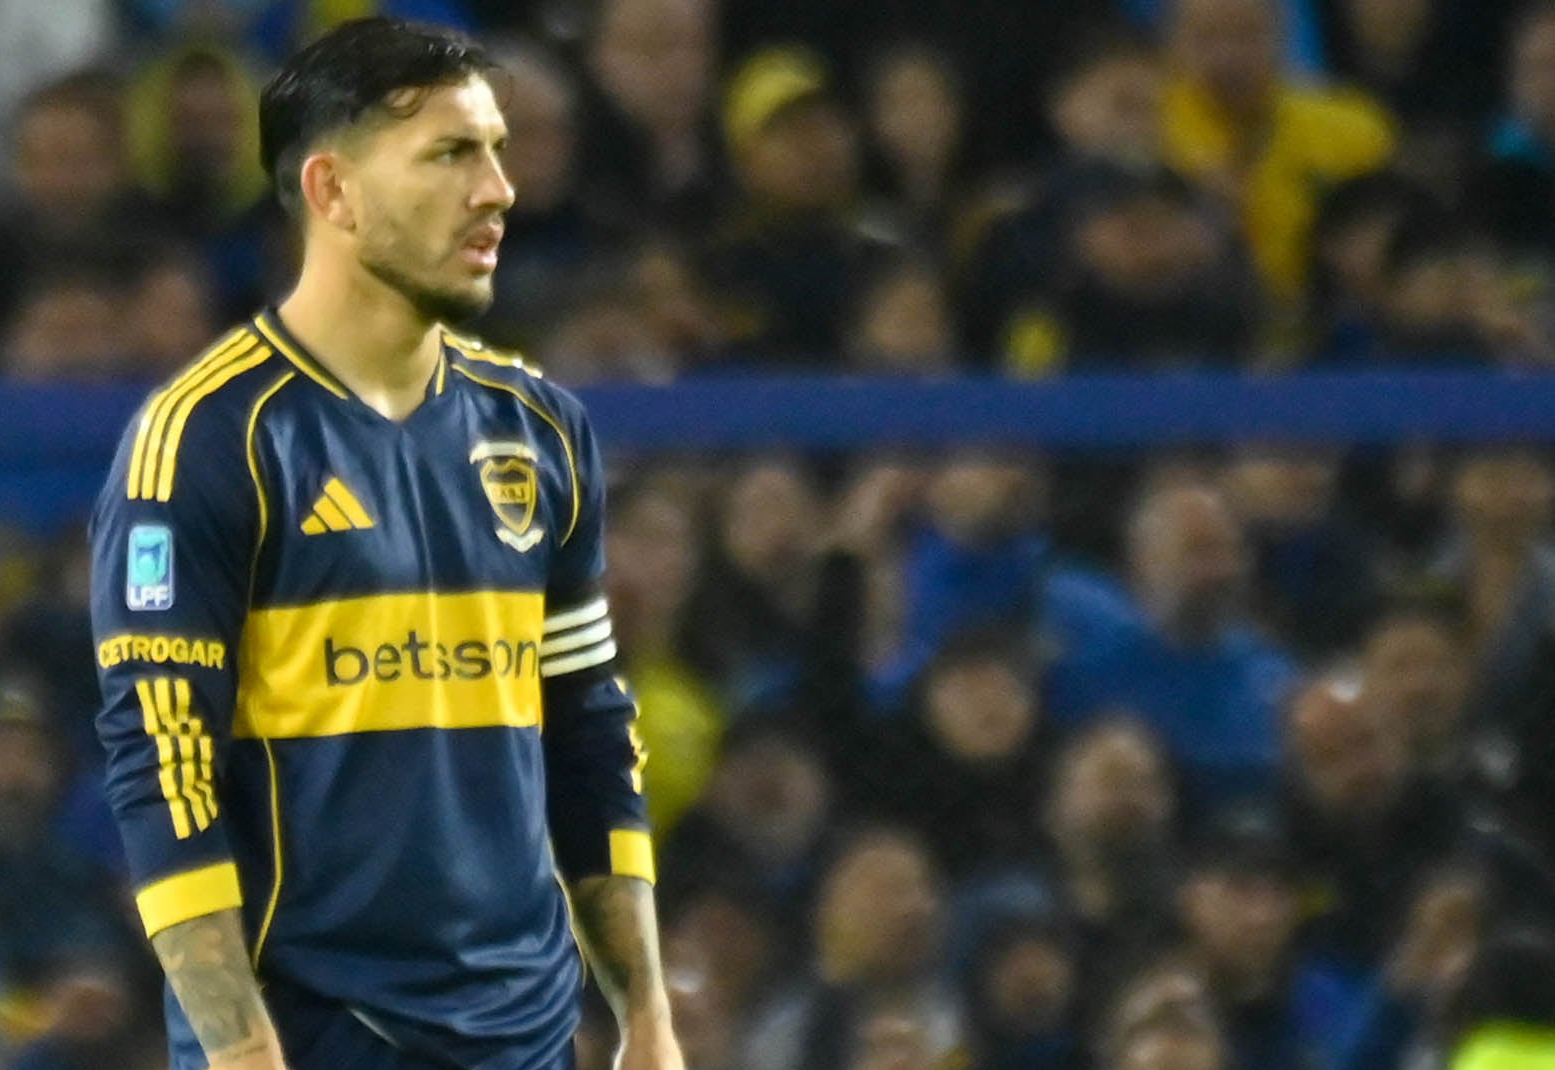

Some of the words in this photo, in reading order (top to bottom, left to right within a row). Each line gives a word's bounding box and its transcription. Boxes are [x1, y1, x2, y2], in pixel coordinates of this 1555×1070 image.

[130, 585, 169, 607] LPF
[98, 634, 227, 670] CETROGAR
[324, 630, 539, 687] betsson
